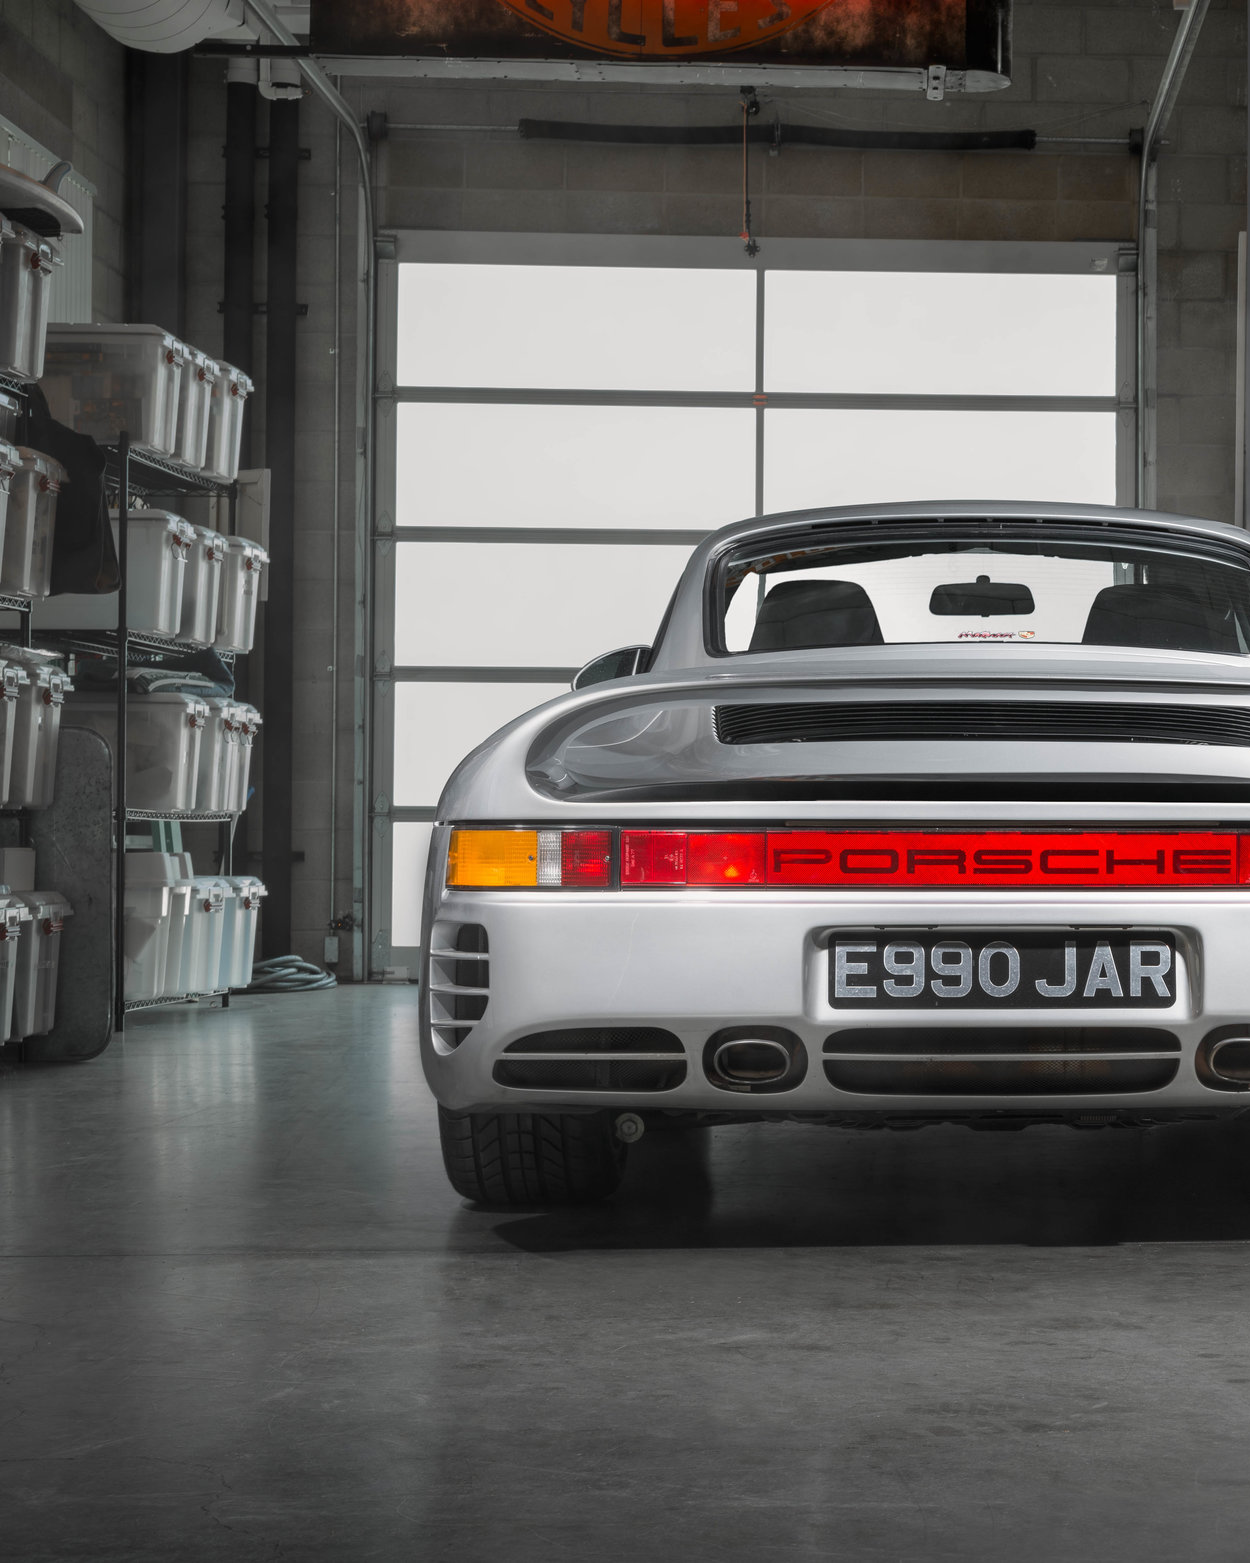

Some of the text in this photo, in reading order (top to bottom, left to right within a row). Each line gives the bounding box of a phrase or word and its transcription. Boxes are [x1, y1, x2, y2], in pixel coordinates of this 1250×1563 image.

[773, 848, 1231, 874] PORSCHE
[835, 940, 1173, 998] E990 JAR
